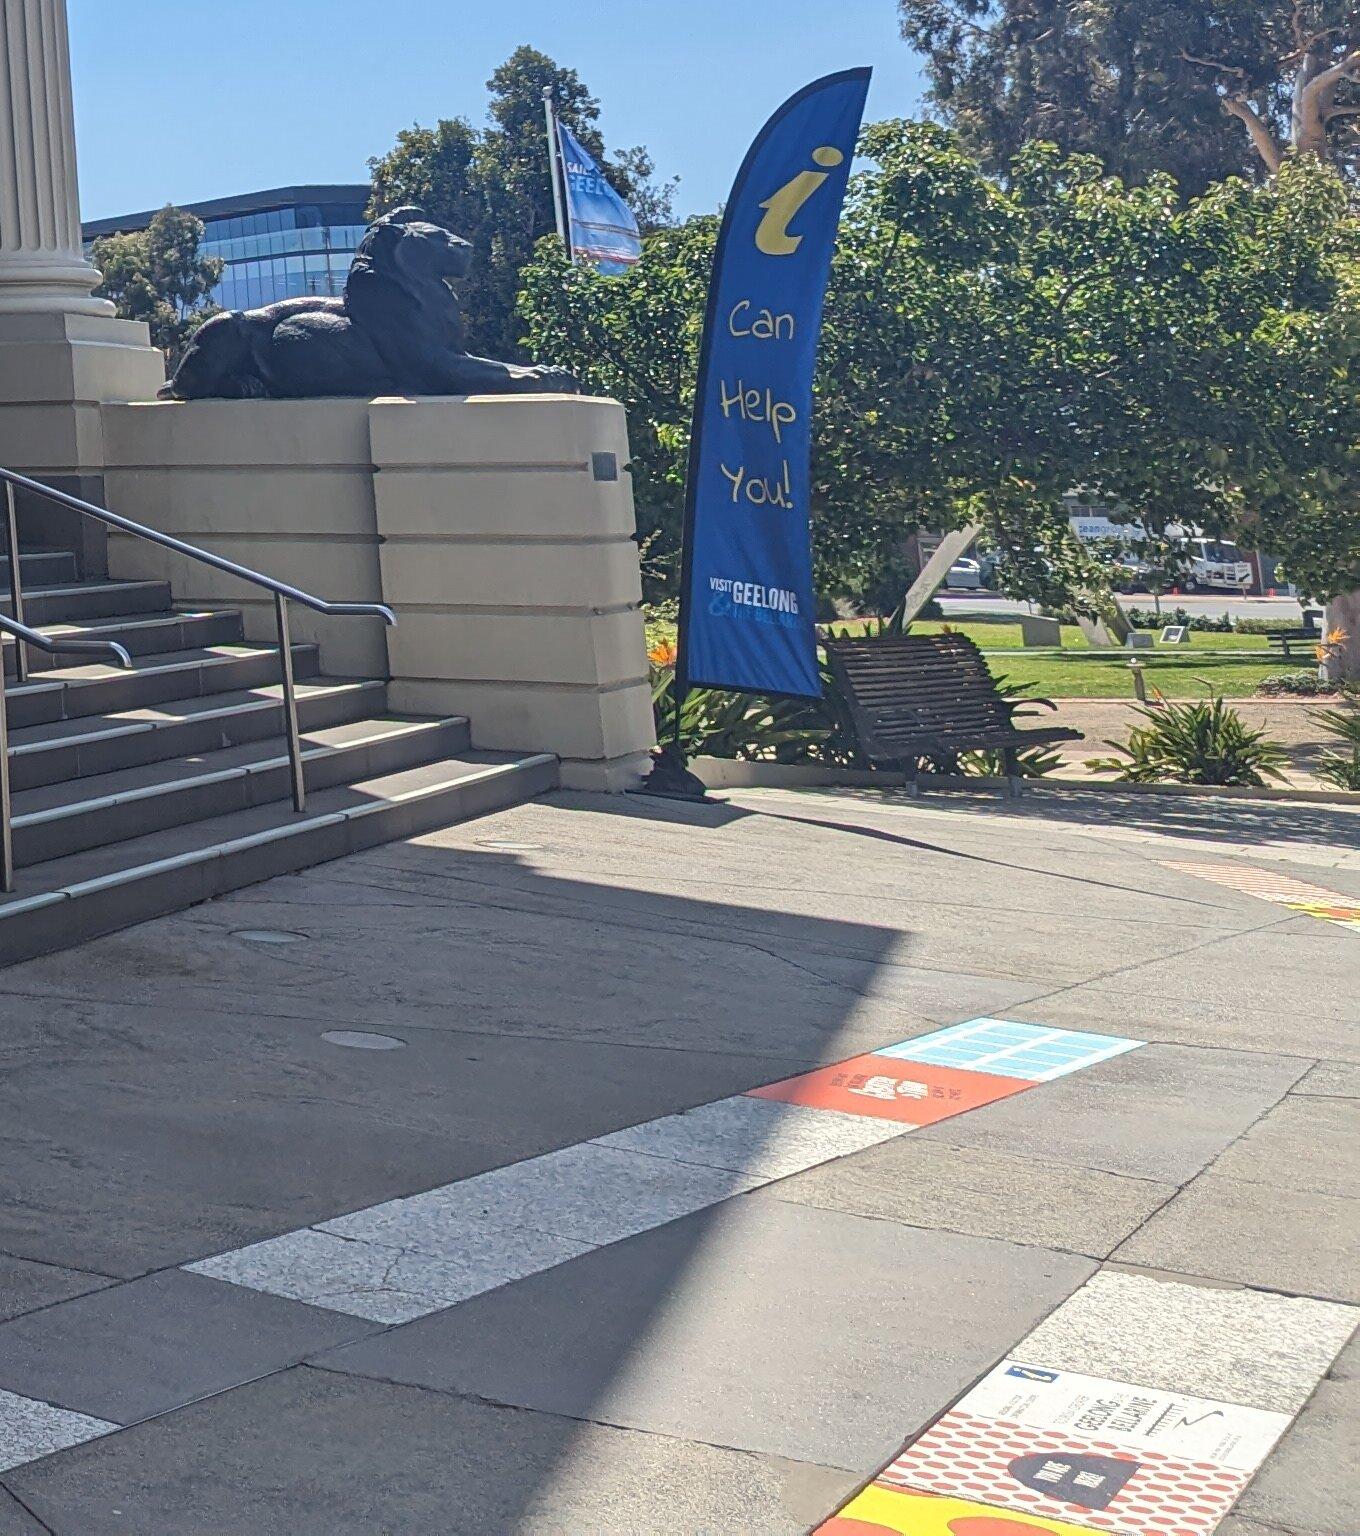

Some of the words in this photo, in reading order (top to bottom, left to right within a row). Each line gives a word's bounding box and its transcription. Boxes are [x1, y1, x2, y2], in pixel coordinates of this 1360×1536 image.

[729, 299, 794, 342] Can
[720, 379, 797, 444] Help
[721, 459, 793, 511] You!
[709, 576, 734, 594] VISIT
[732, 581, 799, 615] GEELONG
